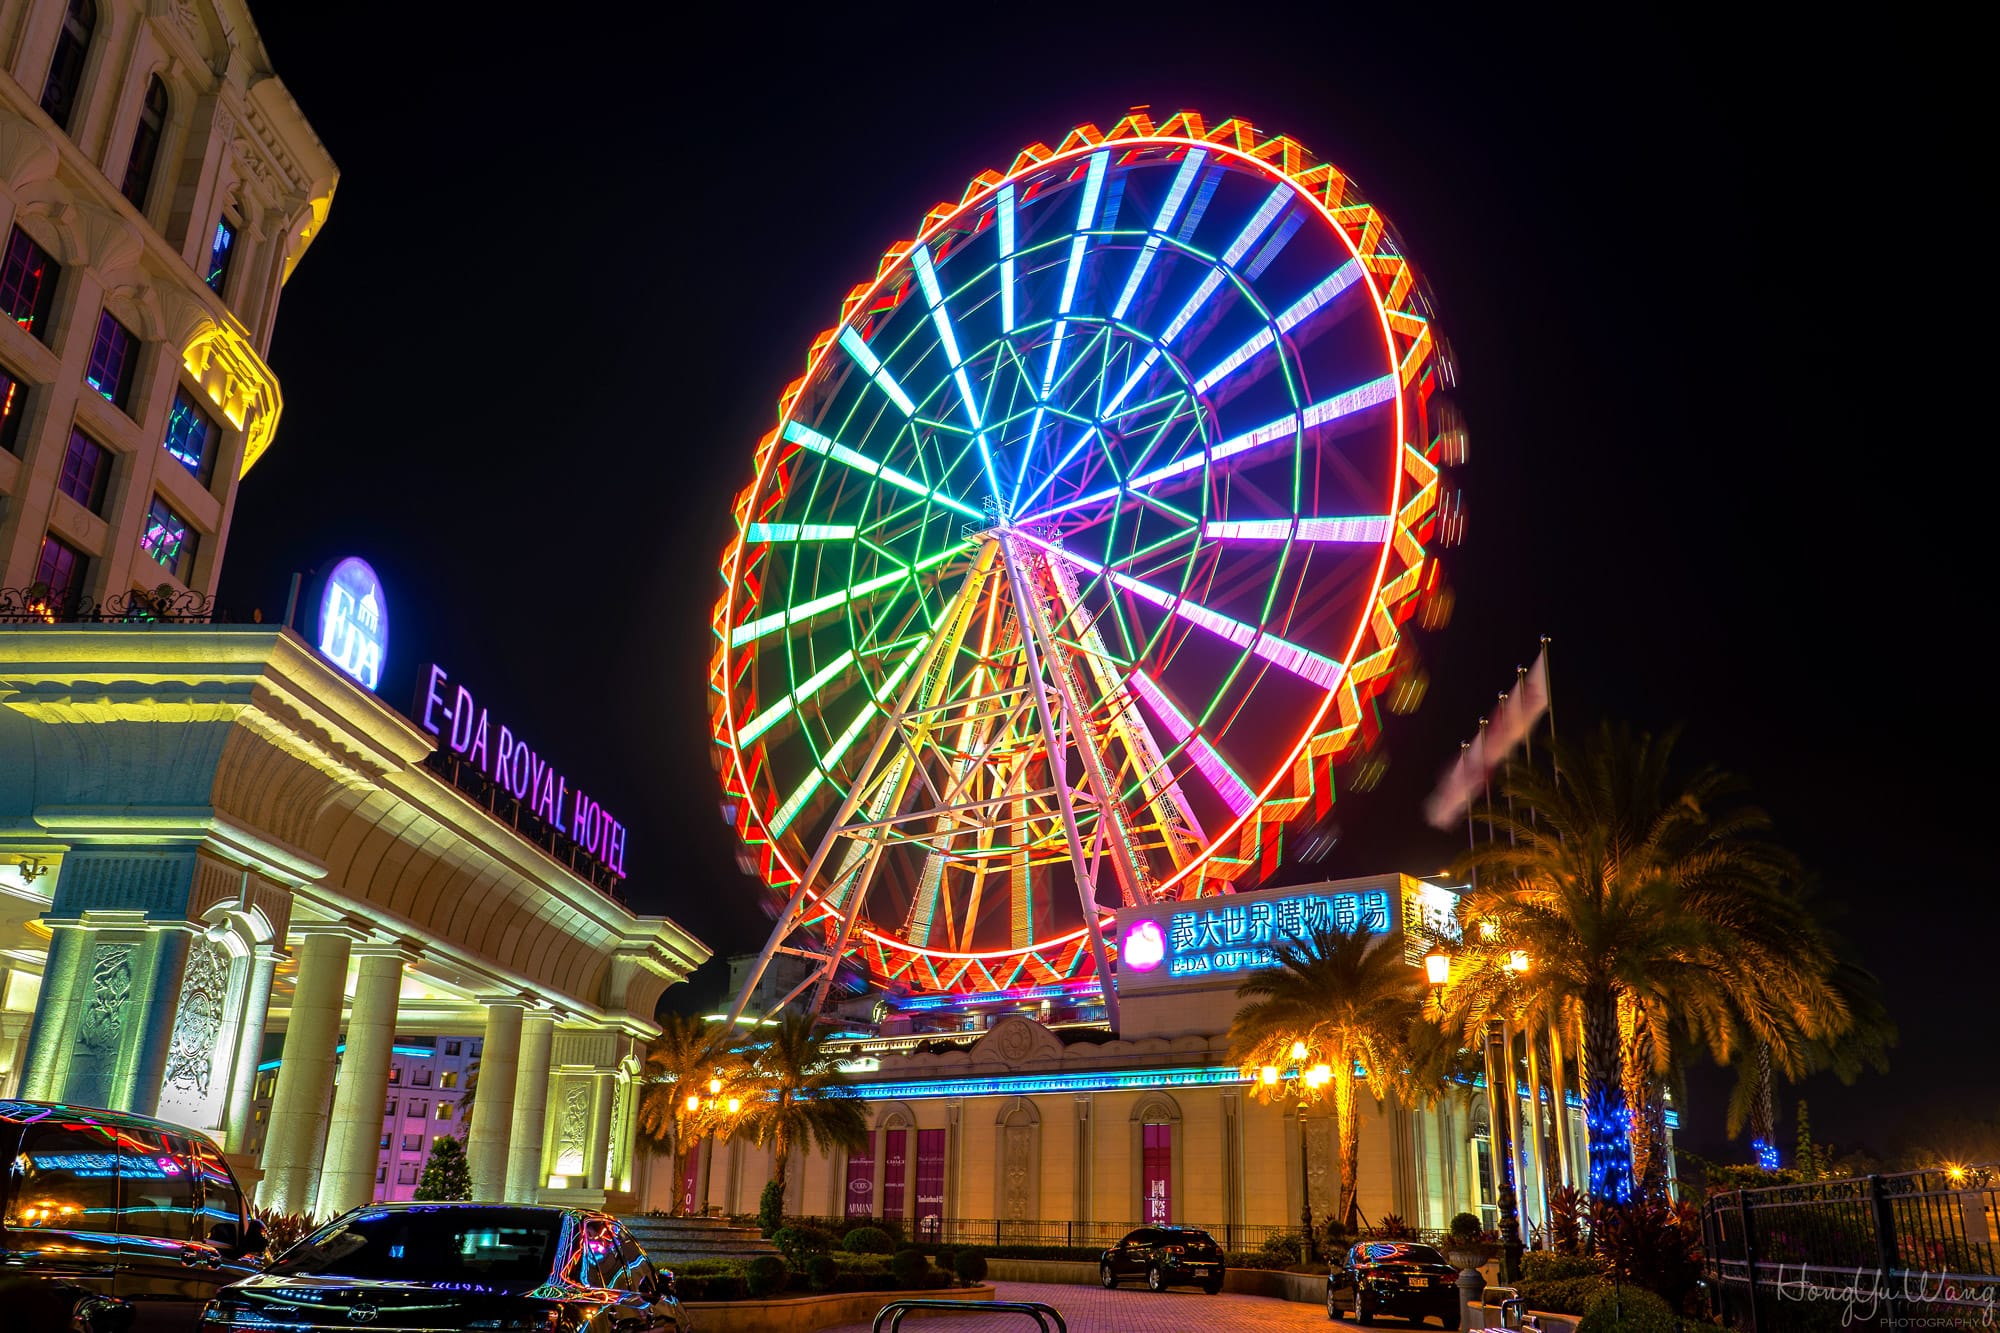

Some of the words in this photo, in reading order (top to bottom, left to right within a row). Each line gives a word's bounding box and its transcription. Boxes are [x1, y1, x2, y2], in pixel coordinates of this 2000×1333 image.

[319, 580, 379, 692] EDA
[424, 664, 488, 772] E-DA
[495, 725, 566, 834] ROYAL
[572, 789, 626, 879] HOTEL
[1171, 892, 1386, 950] 義大世界購物廣場
[1172, 957, 1207, 972] E-DA
